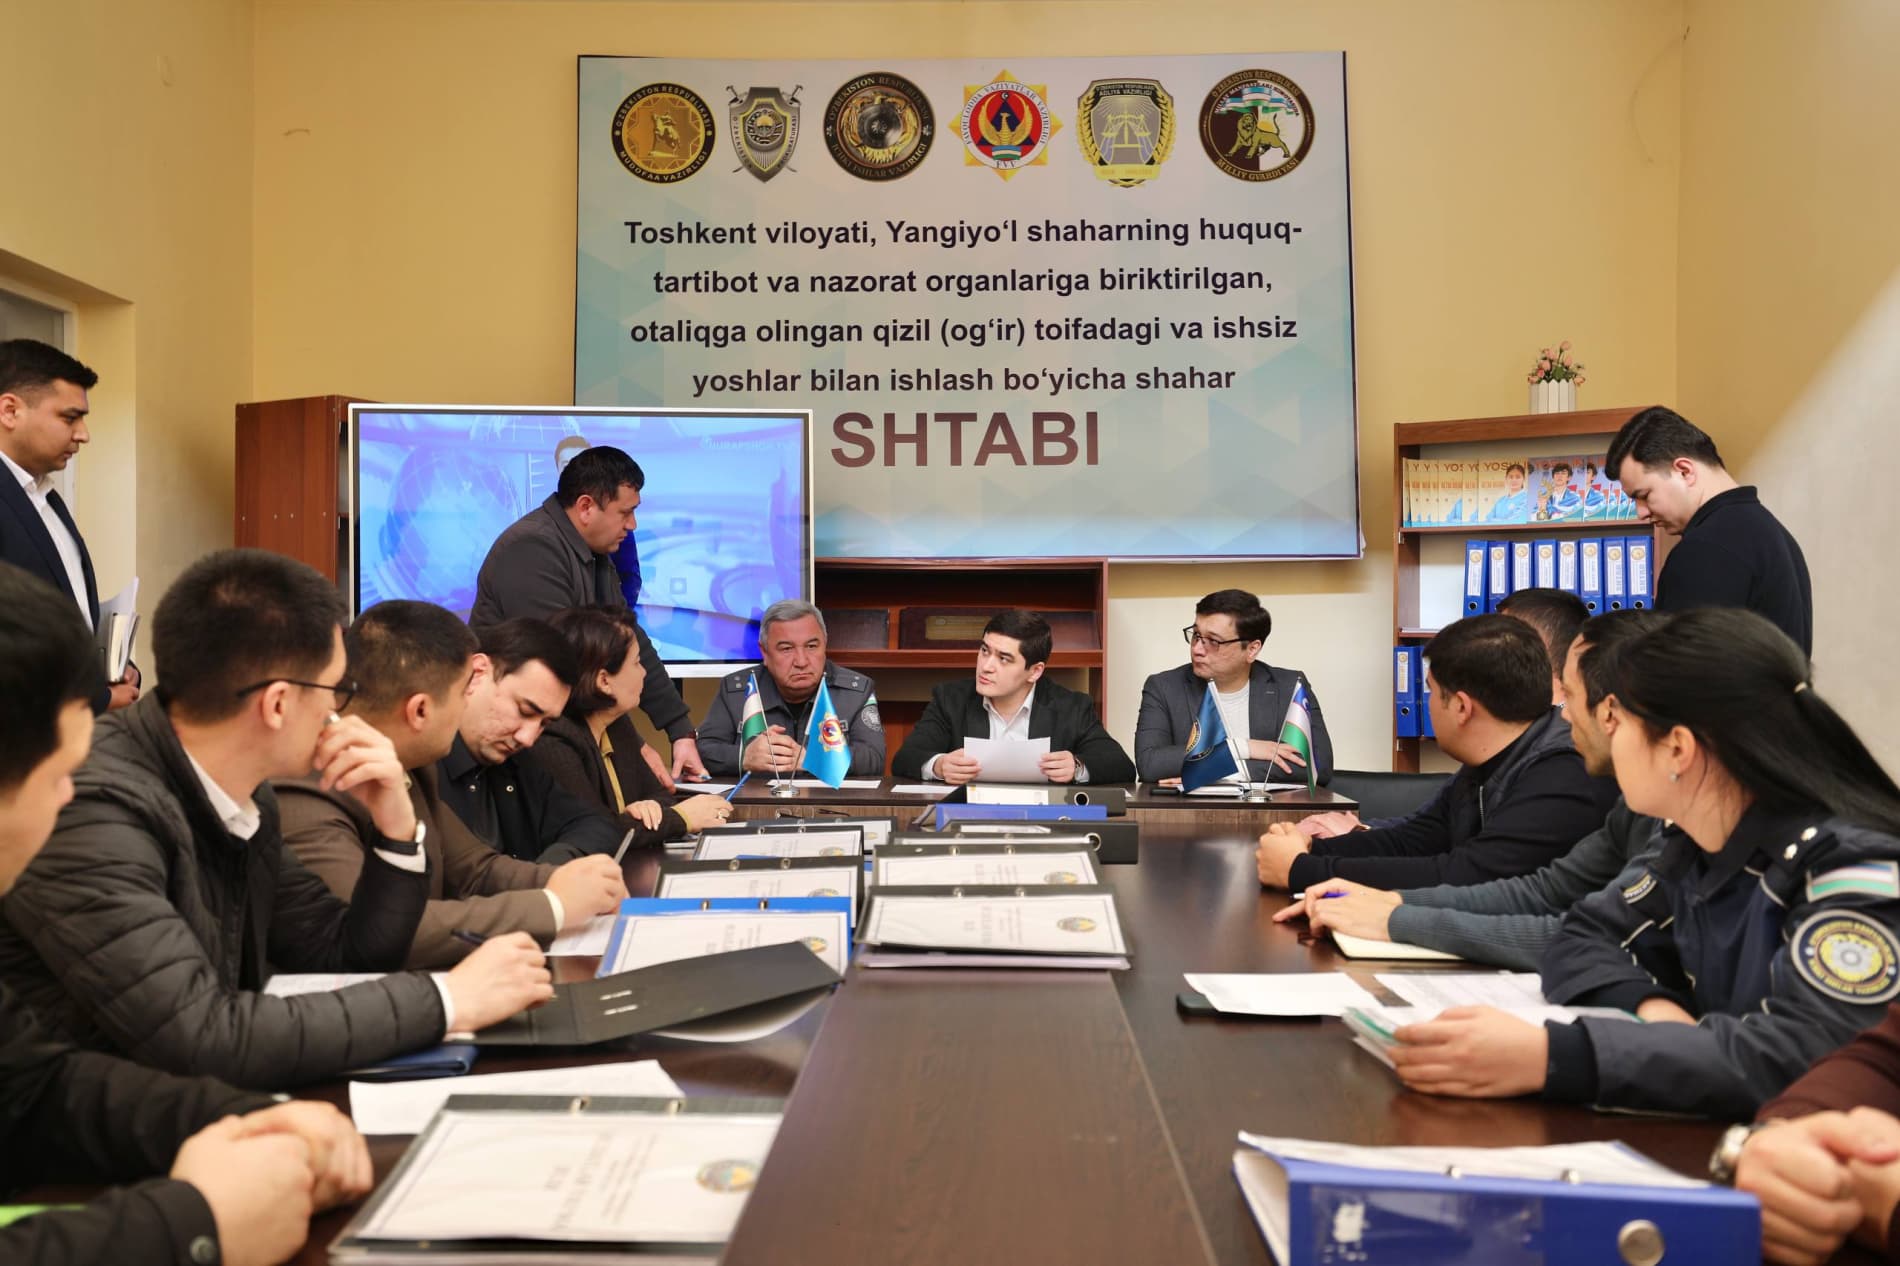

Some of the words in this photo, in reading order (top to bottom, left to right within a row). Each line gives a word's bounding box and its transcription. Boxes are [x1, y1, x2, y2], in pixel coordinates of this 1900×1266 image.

[624, 222, 756, 243] Toshkent
[766, 221, 875, 249] viloyati,
[886, 220, 1016, 248] Yangiyo‘l
[1028, 219, 1188, 246] shaharning
[1200, 218, 1301, 244] huquq-
[654, 271, 757, 292] tartibot
[767, 276, 799, 292] va
[811, 271, 916, 292] nazorat
[927, 269, 1089, 297] organlariga
[1101, 267, 1271, 294] biriktirilgan,
[631, 320, 745, 348] otaliqga
[757, 320, 862, 347] olingan
[874, 319, 929, 347] qizil
[941, 318, 1024, 347] (og‘ir)
[1035, 317, 1159, 345] toifadagi
[1171, 322, 1202, 338] va
[1214, 316, 1297, 338] ishsiz
[693, 370, 801, 397] yoshlar
[812, 369, 879, 391] bilan
[891, 368, 992, 390] ishlash
[1005, 368, 1125, 395] bo‘yicha
[1137, 367, 1235, 389] shahar
[831, 412, 1098, 467] SHTABI
